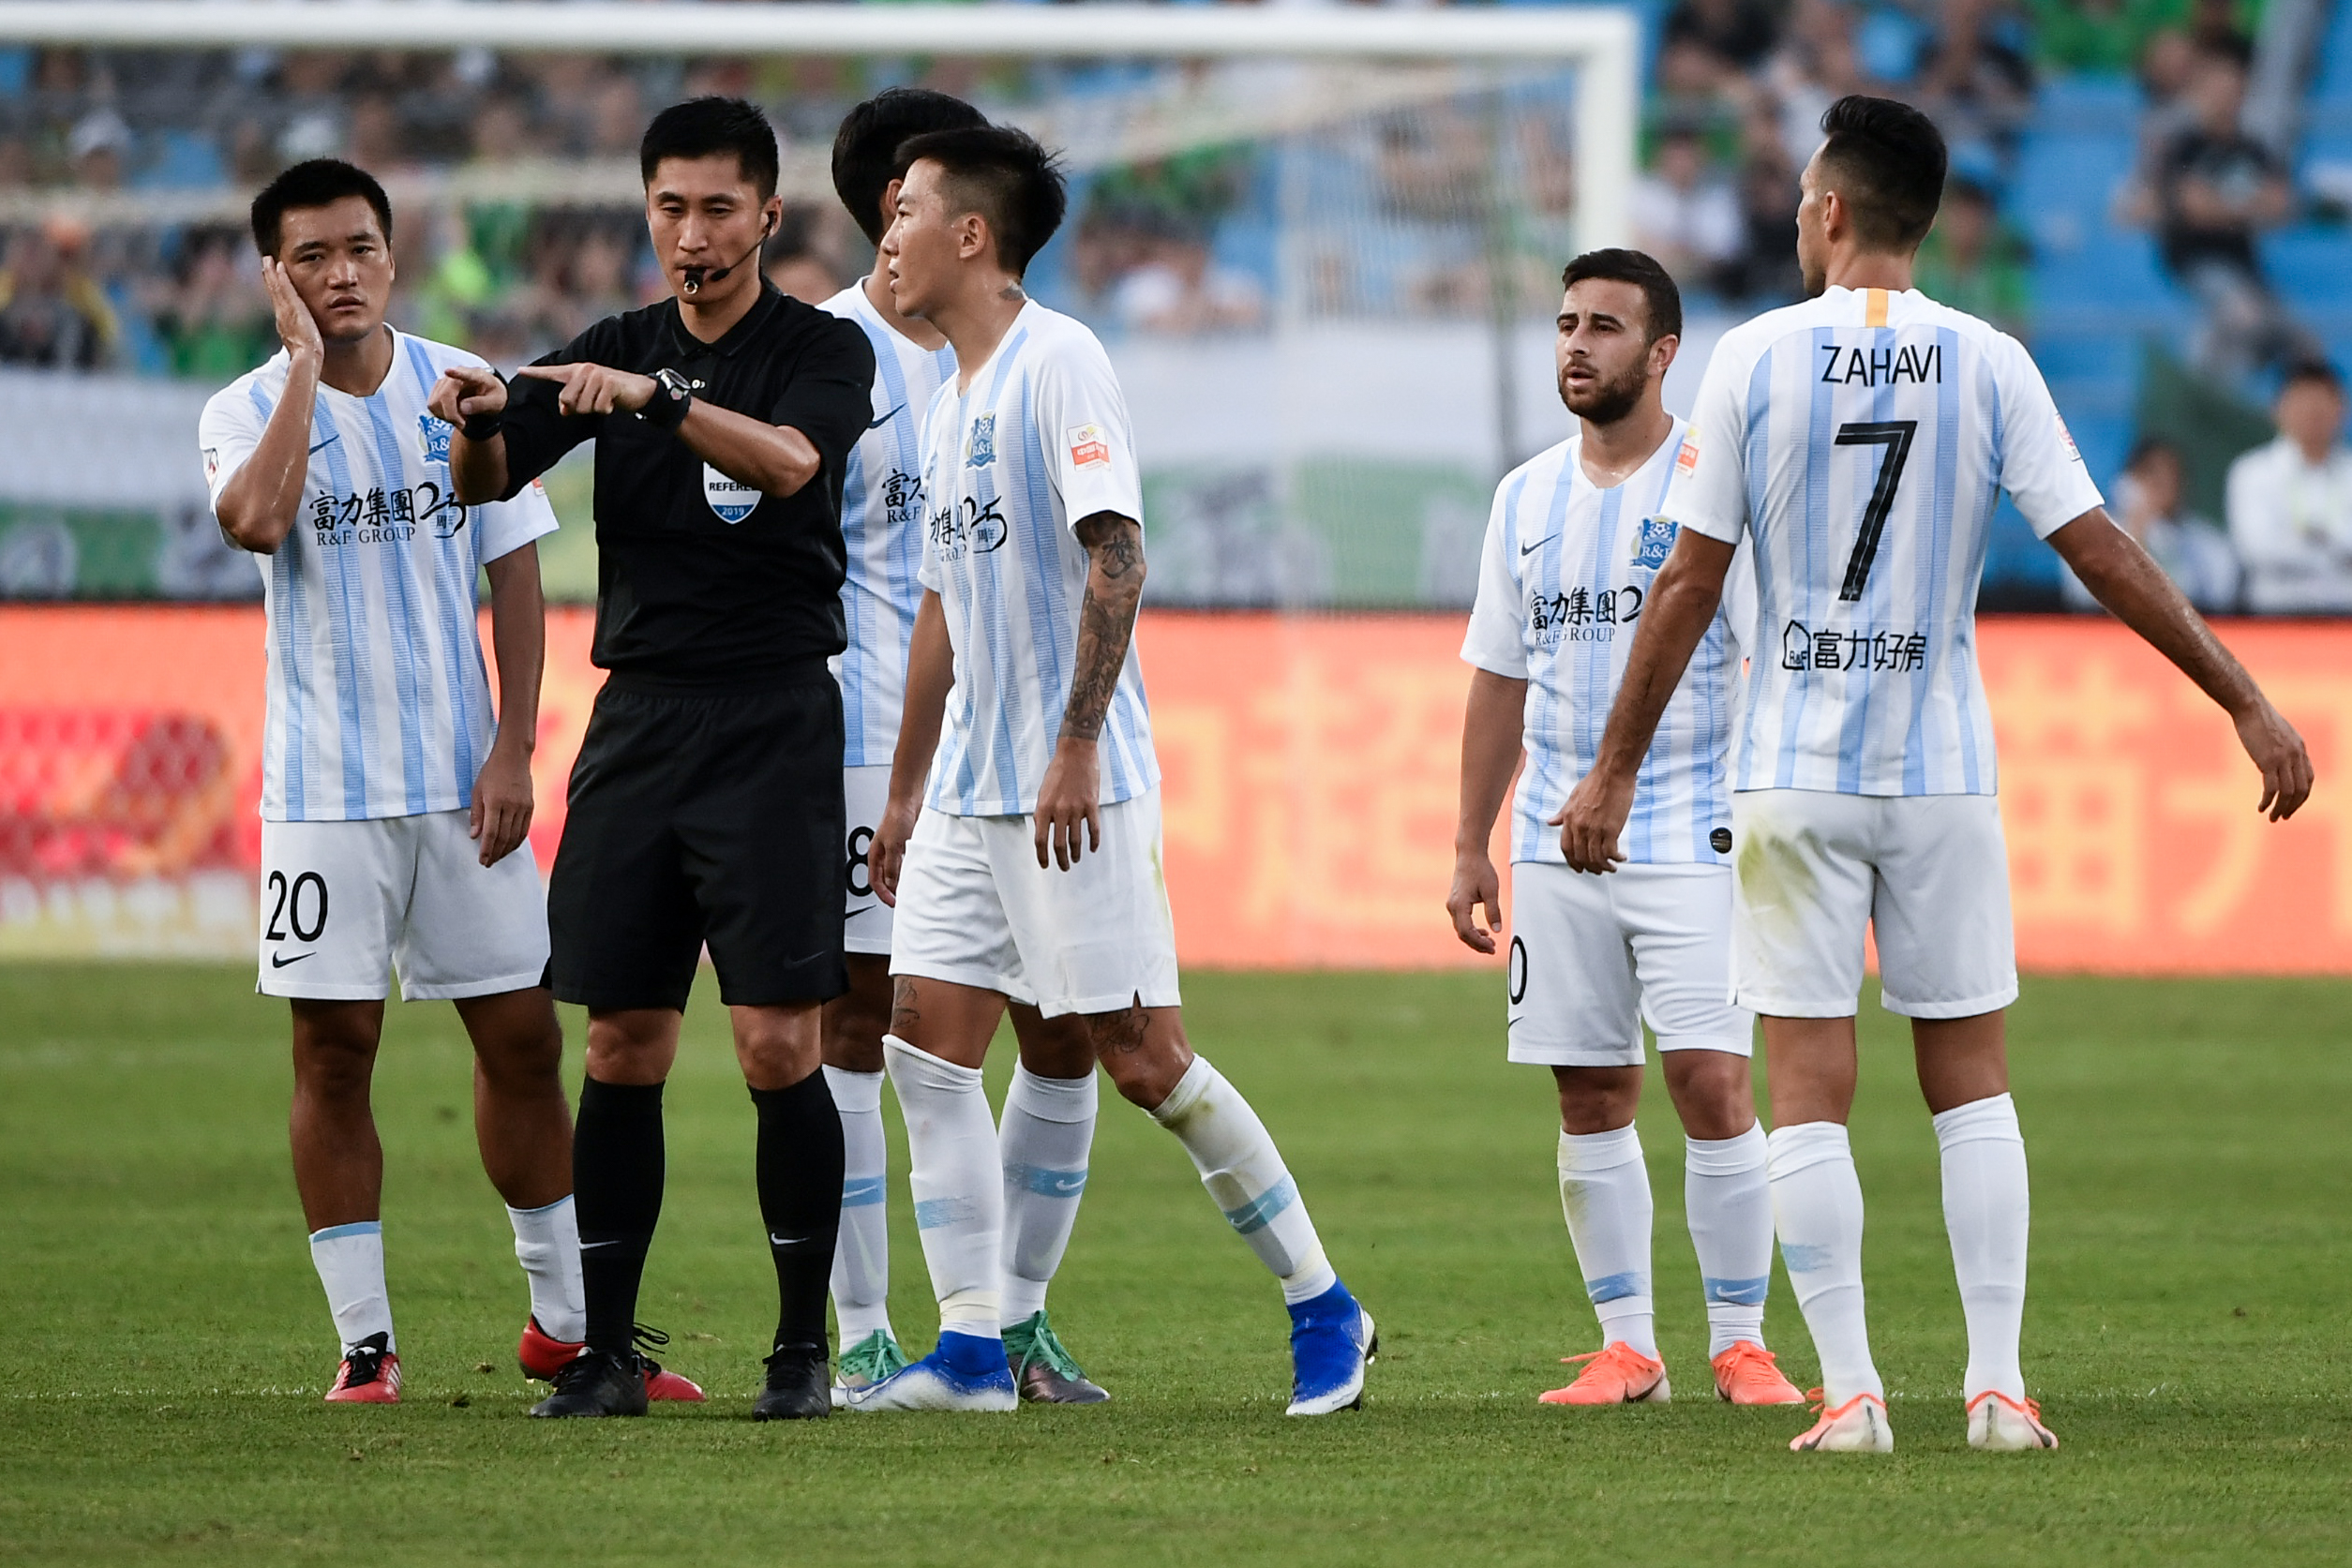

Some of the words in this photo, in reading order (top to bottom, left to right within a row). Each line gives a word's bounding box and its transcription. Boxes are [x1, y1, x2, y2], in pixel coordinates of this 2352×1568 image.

[1821, 344, 1941, 387] ZAHAVI
[722, 507, 744, 515] 2019
[887, 506, 921, 523] R&F
[1835, 421, 1918, 602] 7
[317, 530, 352, 545] R&F
[358, 527, 415, 544] GROUP
[1813, 628, 1927, 673] 富力好房
[265, 870, 328, 942] 20
